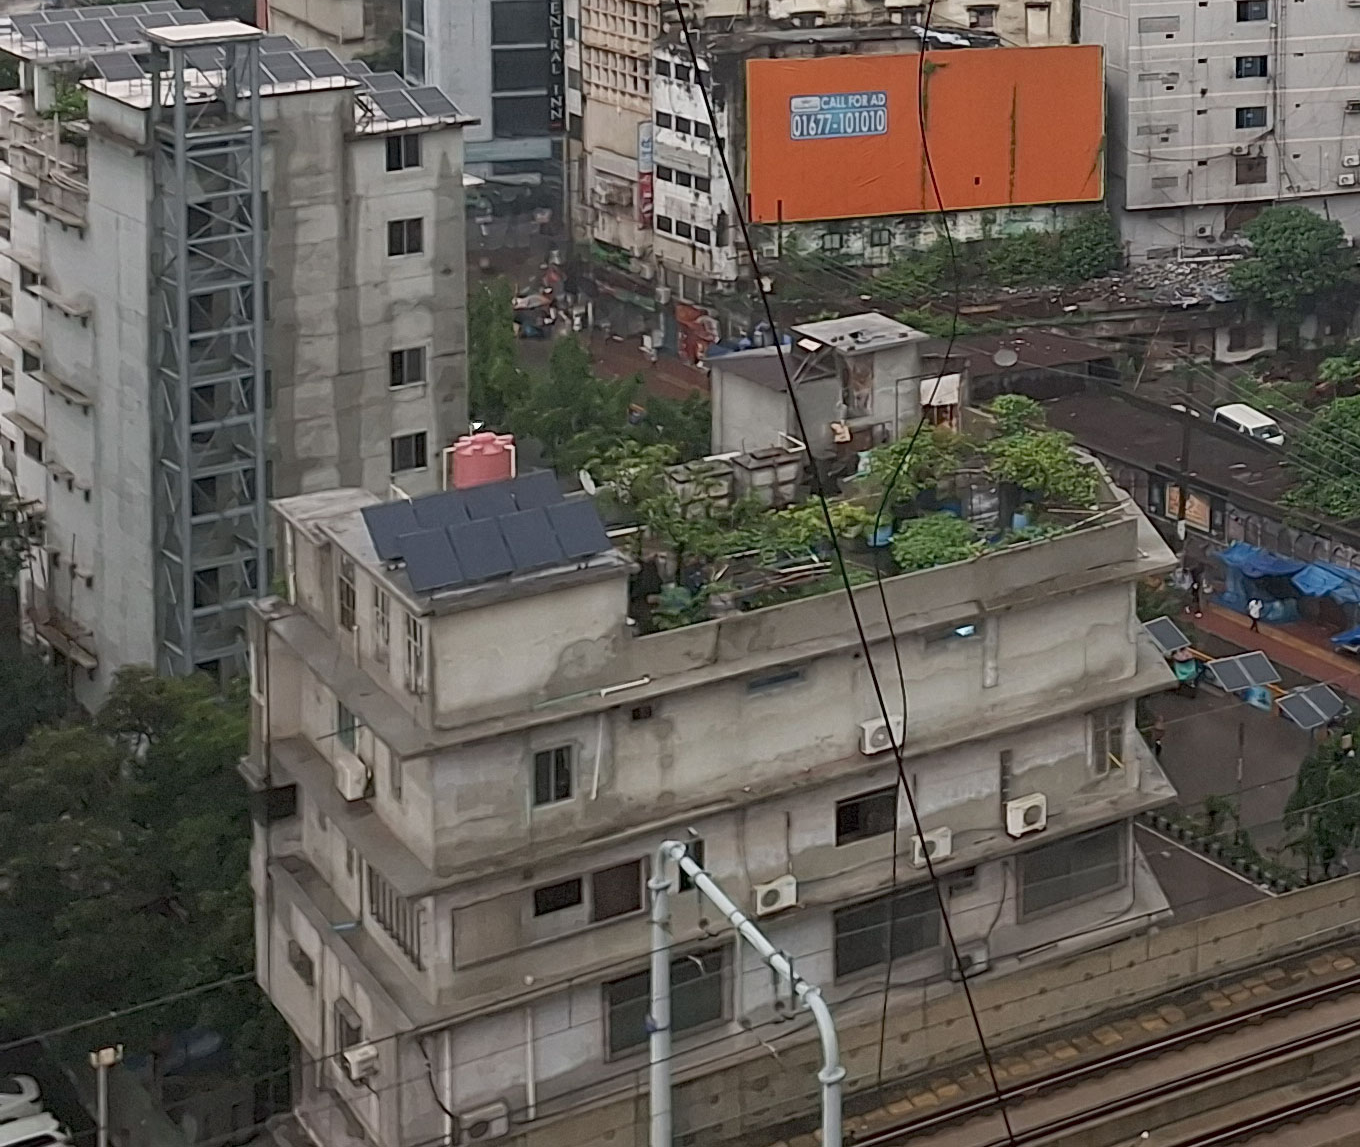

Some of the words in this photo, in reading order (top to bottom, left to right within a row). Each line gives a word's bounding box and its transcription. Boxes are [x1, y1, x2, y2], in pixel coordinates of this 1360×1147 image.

[550, 84, 563, 121] INN
[821, 96, 847, 109] CALL
[848, 94, 869, 108] FOR
[870, 93, 886, 106] AD
[793, 110, 885, 137] 01677-101010
